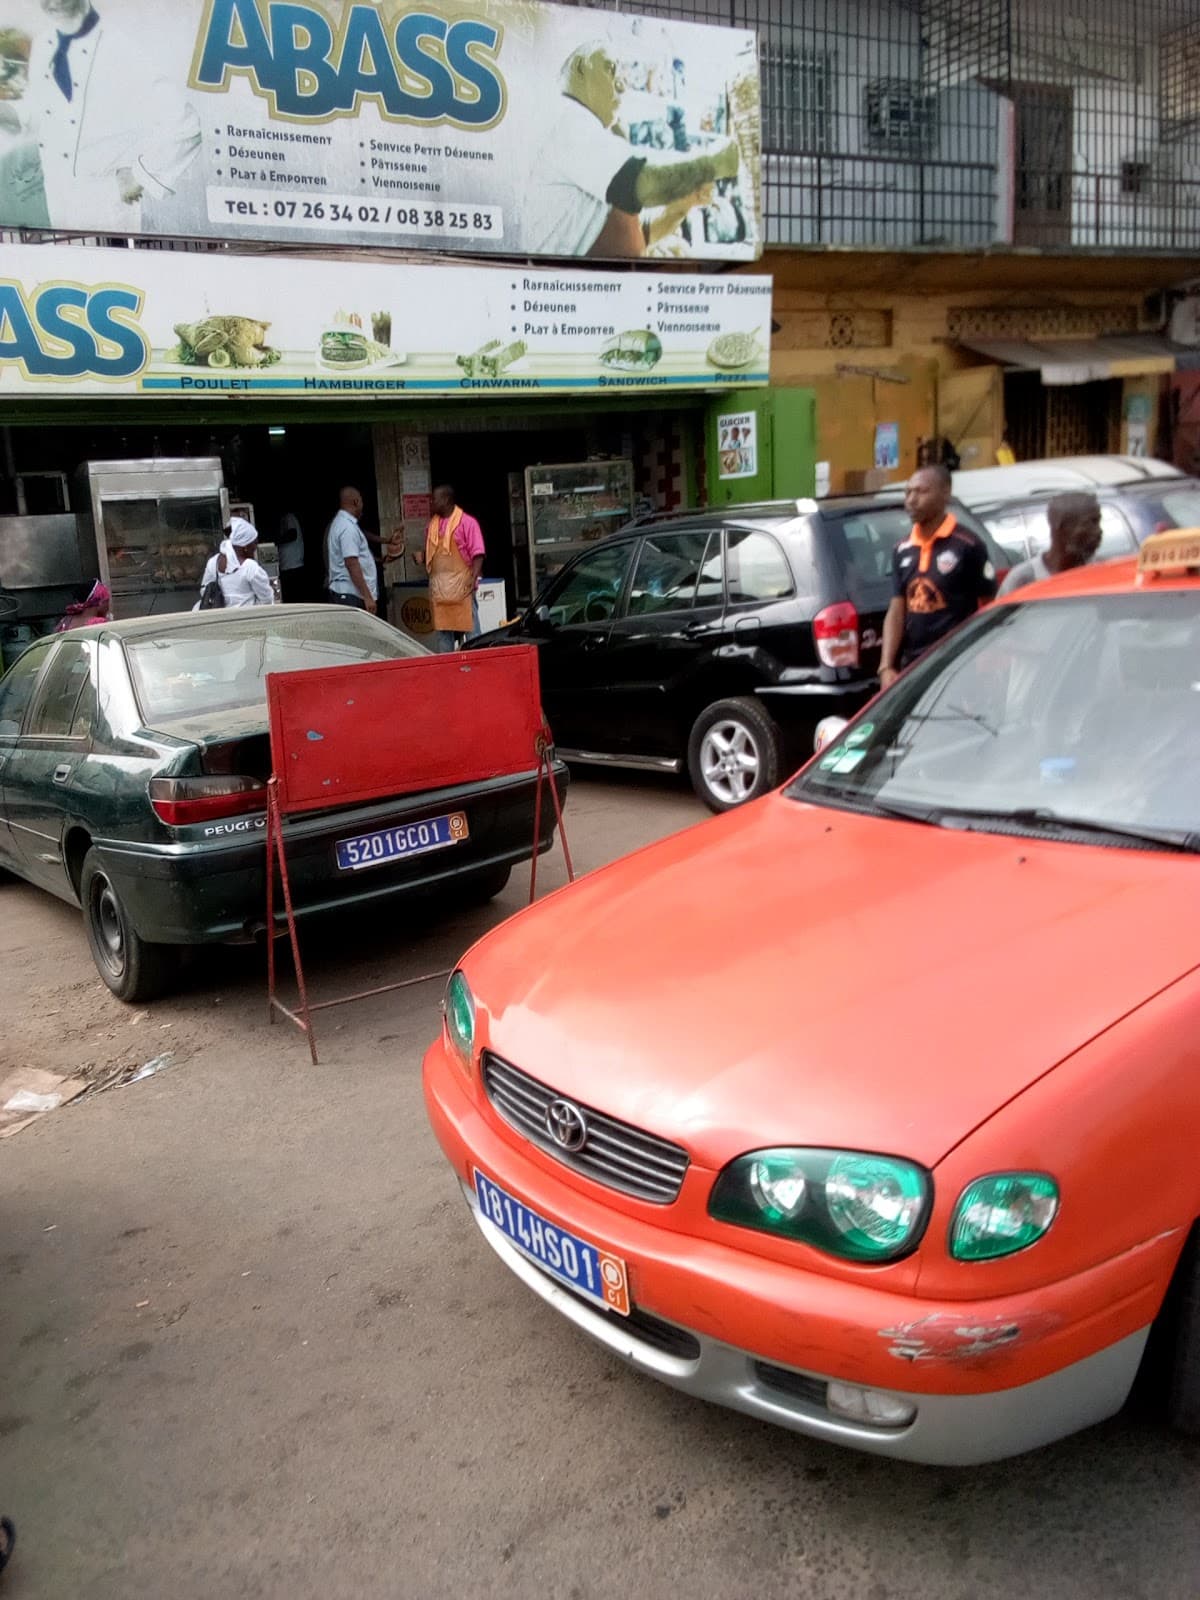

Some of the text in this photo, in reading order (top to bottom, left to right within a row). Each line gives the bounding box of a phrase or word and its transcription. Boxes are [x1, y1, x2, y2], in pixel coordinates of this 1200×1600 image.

[193, 0, 504, 127] ABASS
[274, 200, 297, 219] 07
[302, 202, 325, 220] 26
[330, 203, 353, 223] 34
[357, 206, 380, 223] 02
[397, 208, 419, 225] 08
[423, 208, 445, 227] 38
[449, 211, 469, 229] 25
[472, 213, 493, 231] 83
[204, 817, 267, 837] PEUGEO
[346, 821, 440, 863] 5201GC01
[479, 1178, 595, 1290] 1814HS01
